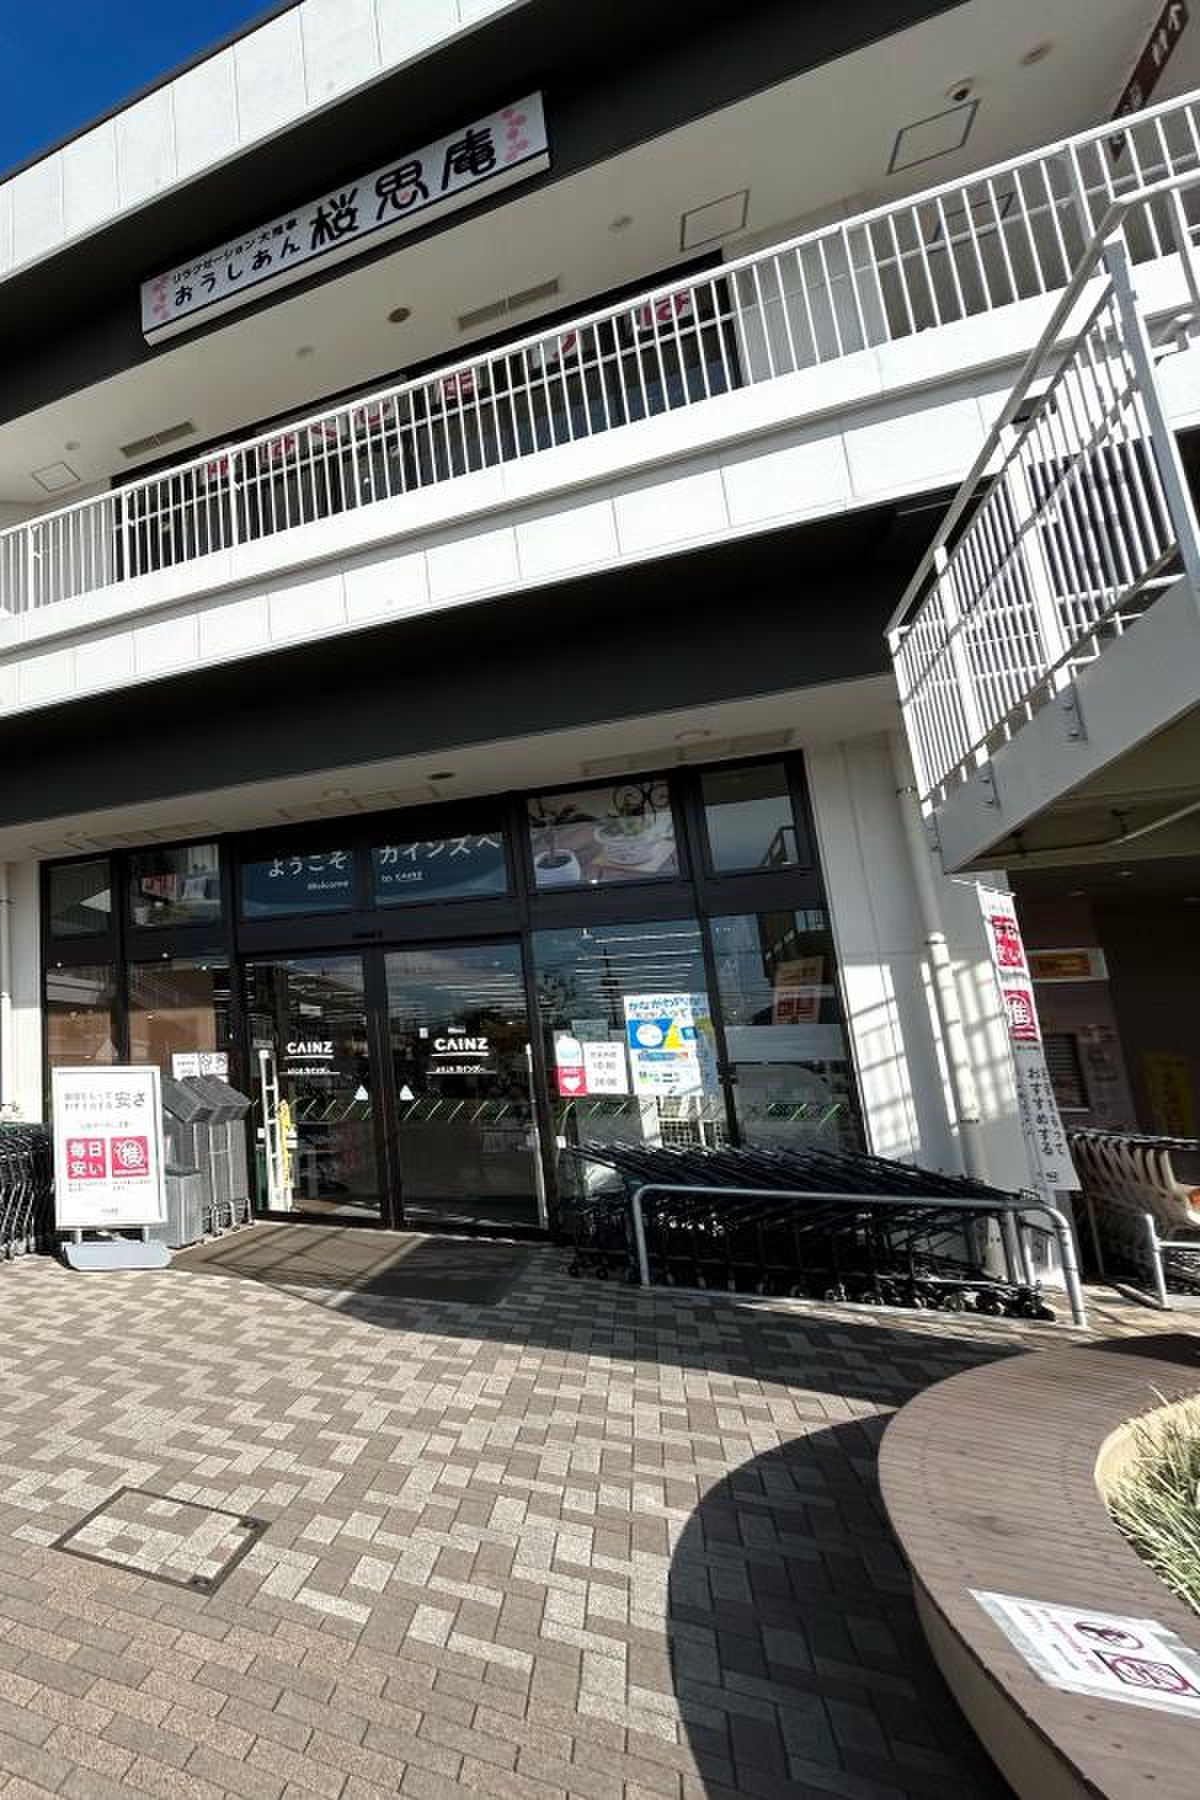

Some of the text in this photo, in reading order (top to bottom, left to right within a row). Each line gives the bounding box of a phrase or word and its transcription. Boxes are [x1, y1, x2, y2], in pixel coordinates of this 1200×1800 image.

[308, 126, 498, 252] 桜思庵
[175, 235, 301, 306] おうしあん
[269, 834, 500, 877] ようこそ カインズへ
[286, 1041, 334, 1054] CAINZ
[433, 1037, 490, 1051] CAINZ
[115, 1090, 145, 1109] 安さ
[71, 1161, 104, 1177] 安い
